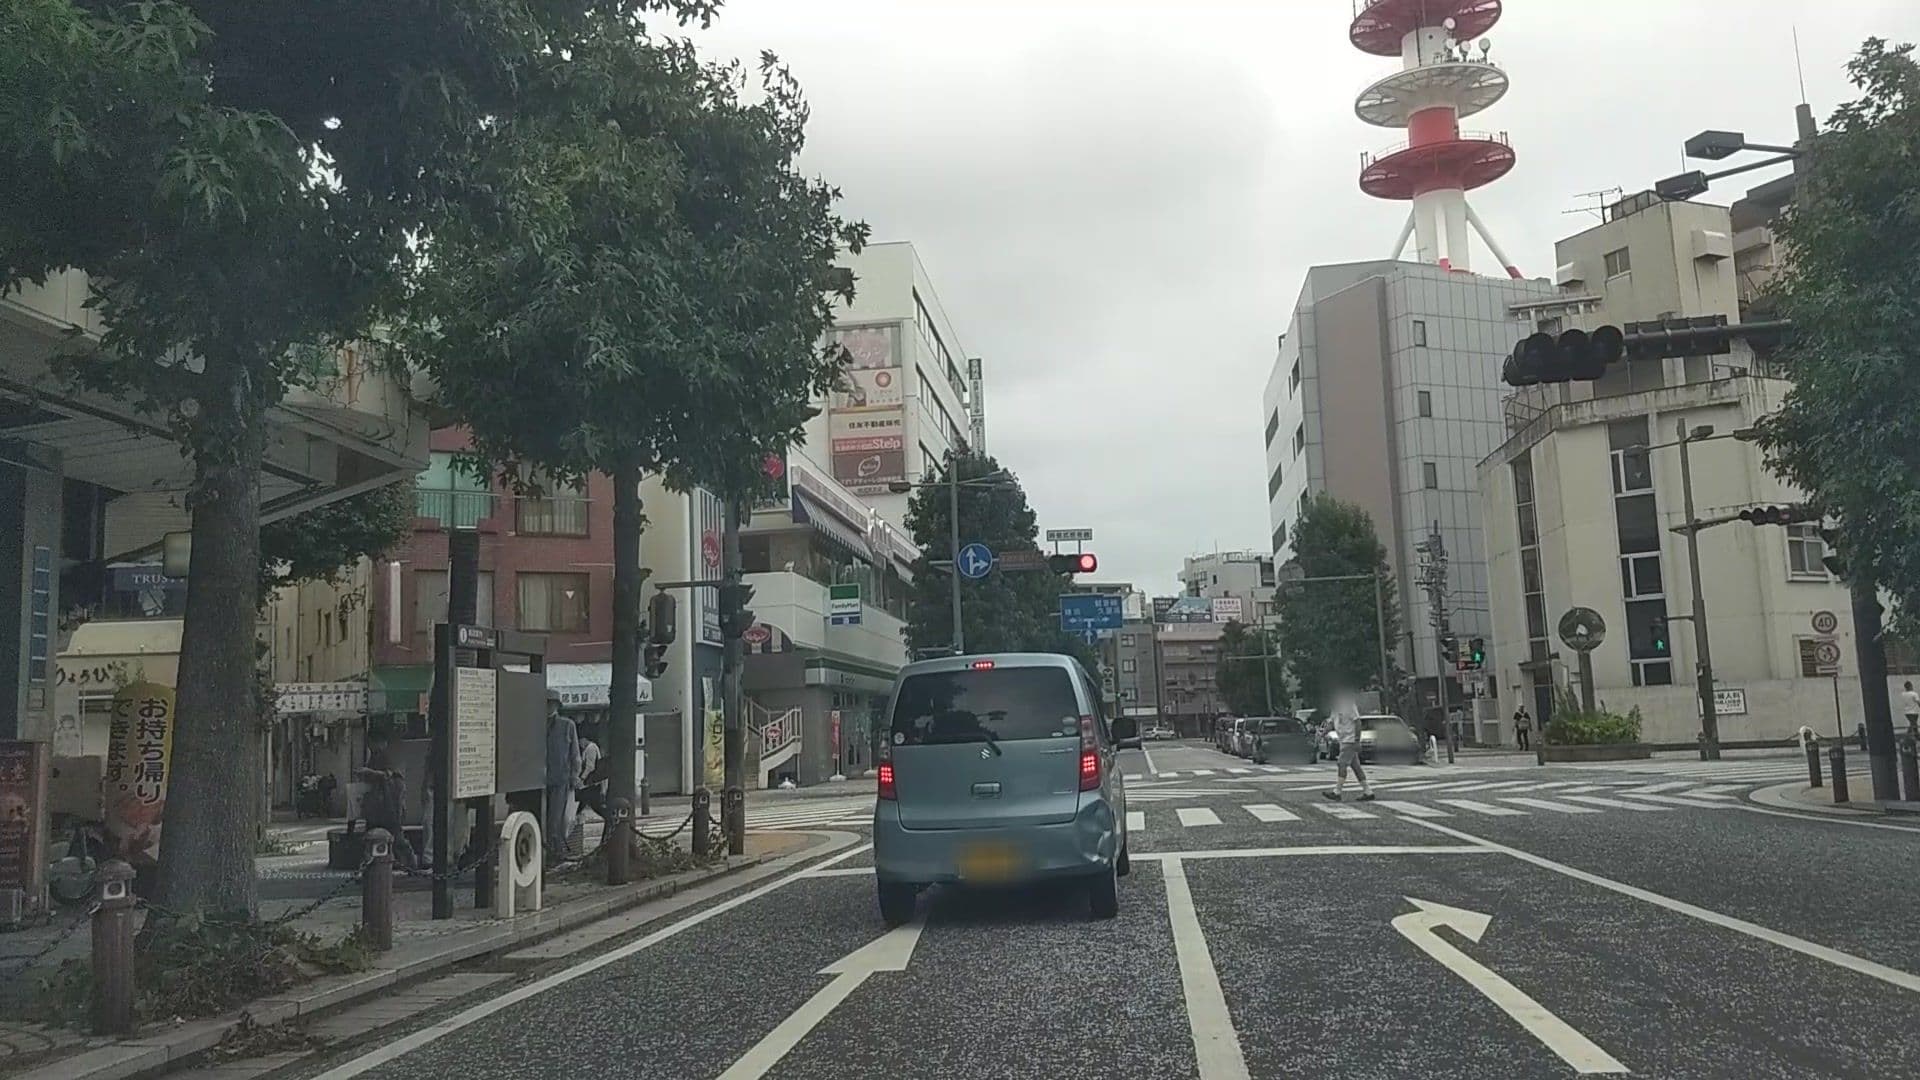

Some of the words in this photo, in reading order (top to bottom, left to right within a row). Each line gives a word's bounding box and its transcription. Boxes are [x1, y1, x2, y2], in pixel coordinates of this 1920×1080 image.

[873, 438, 900, 449] Step
[1817, 617, 1832, 628] 40
[135, 697, 169, 805] お持ち帰り
